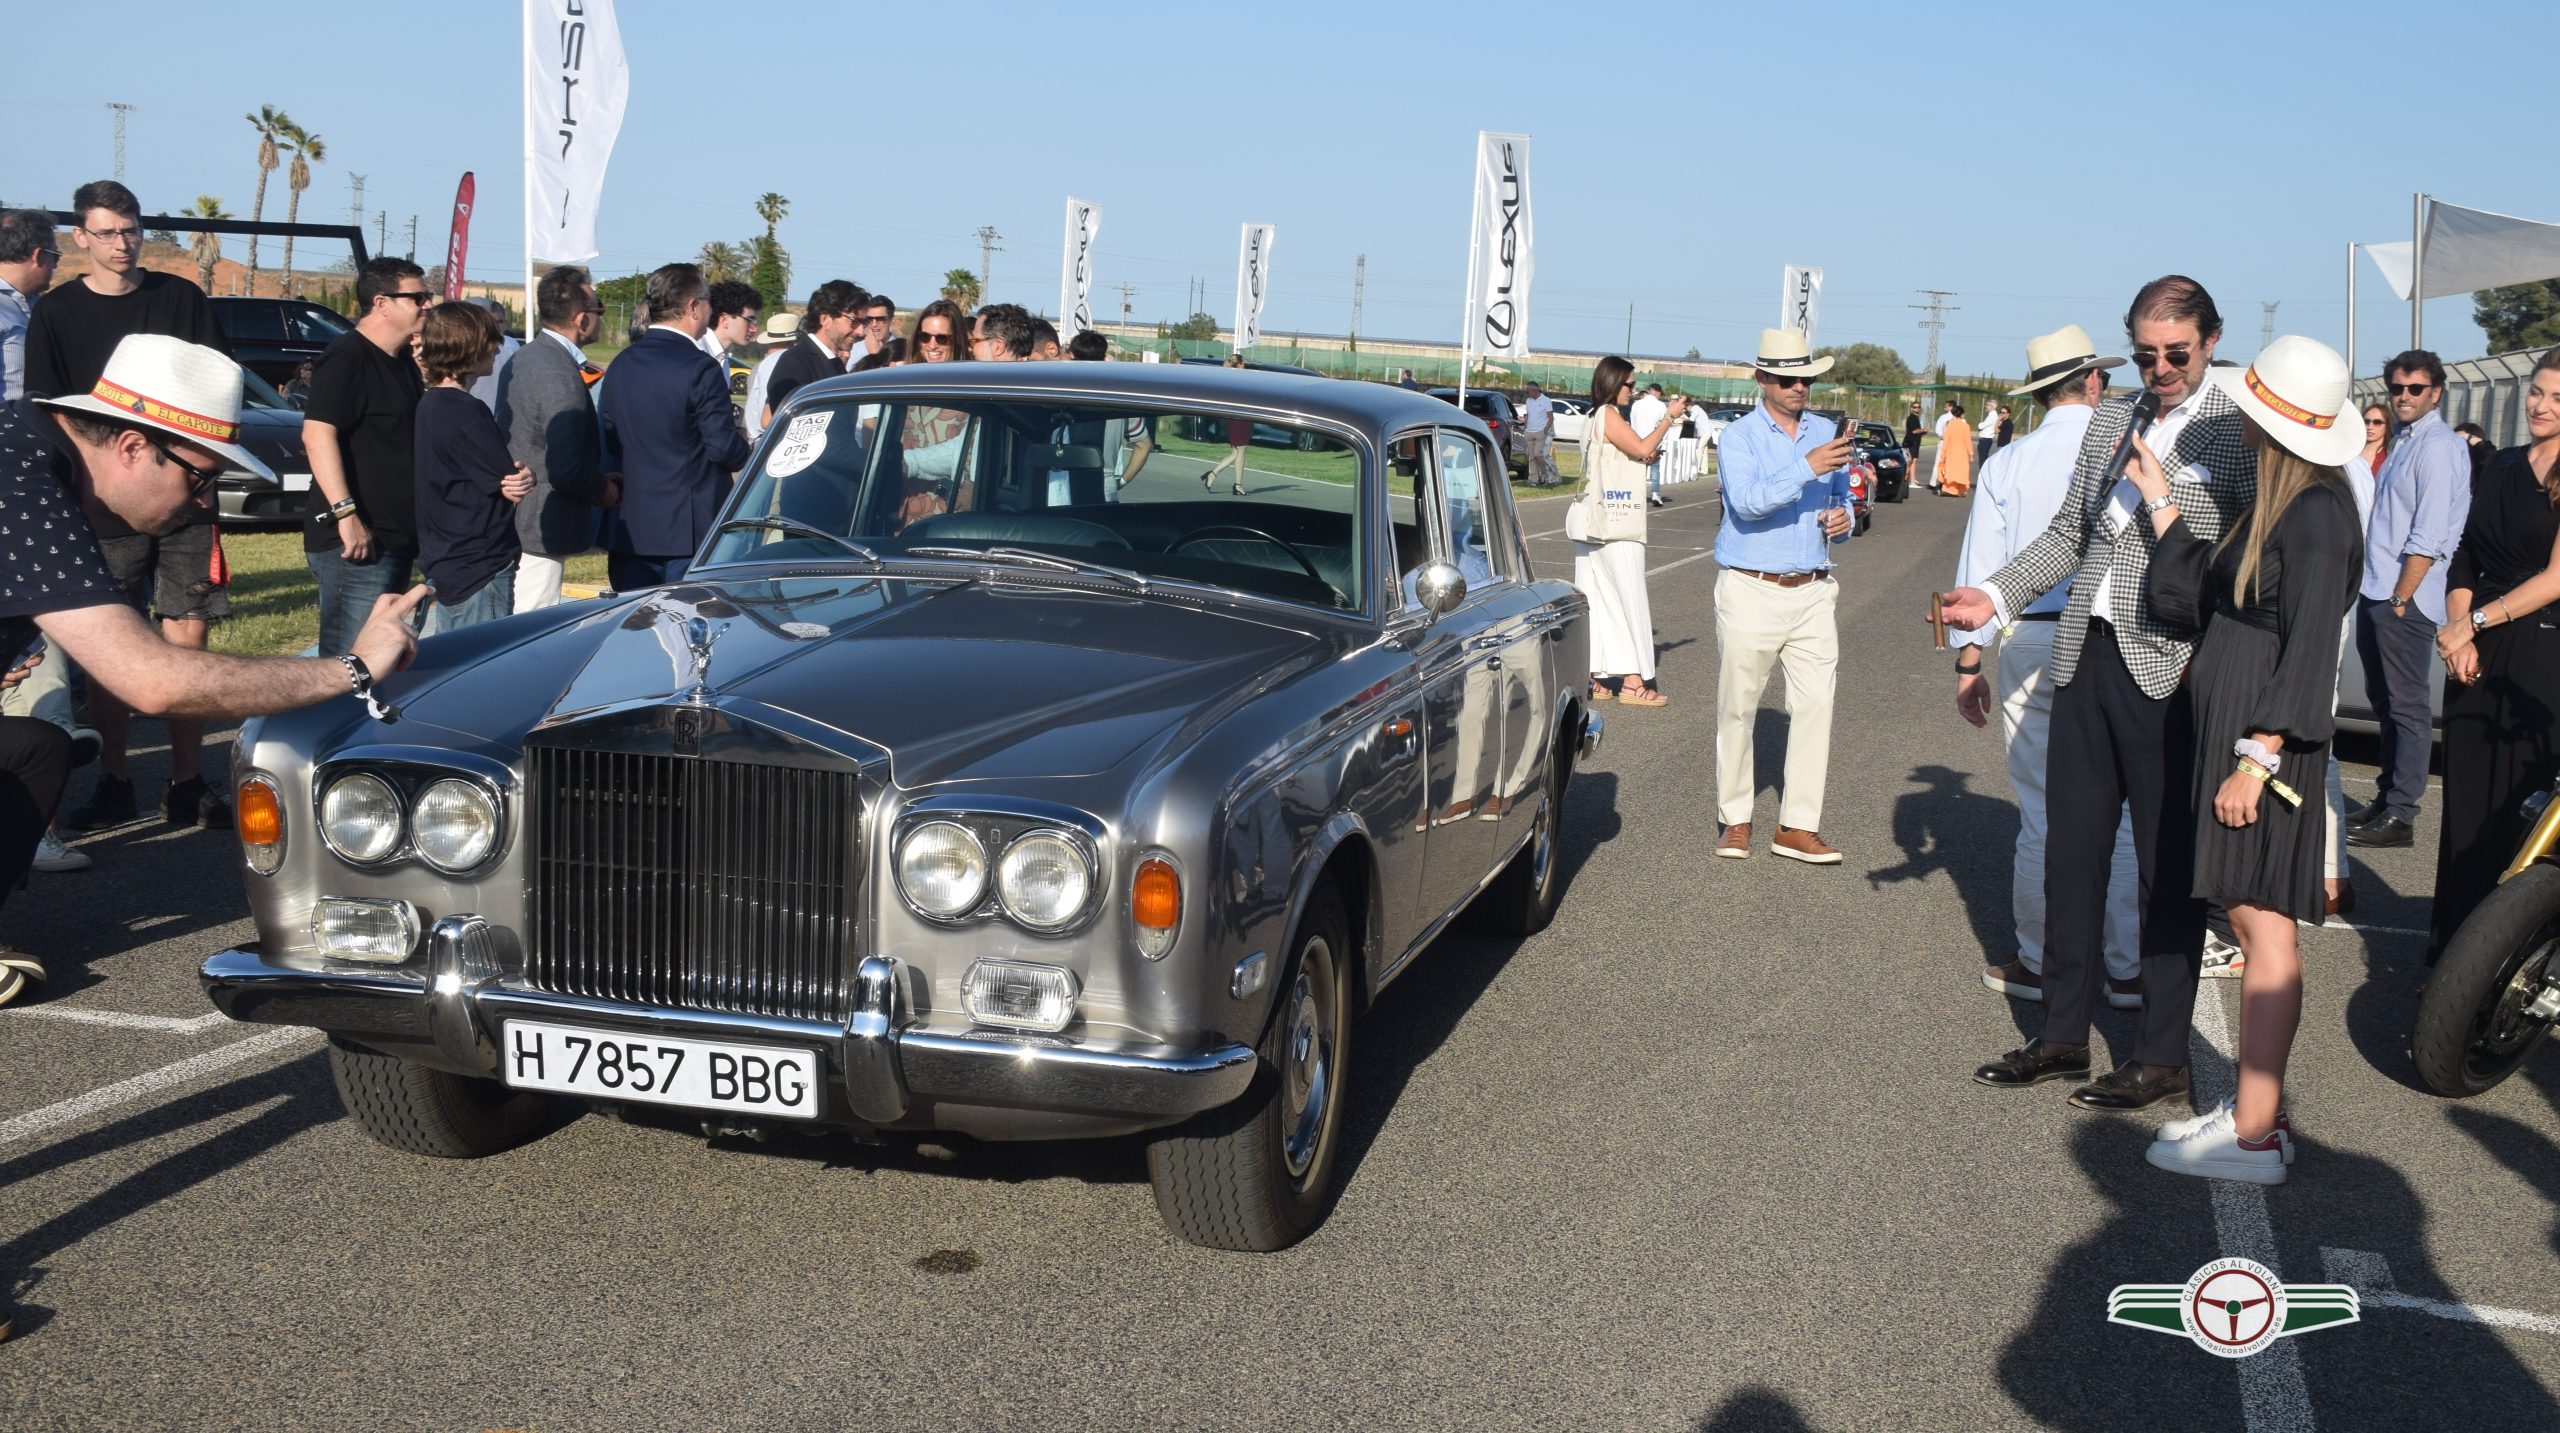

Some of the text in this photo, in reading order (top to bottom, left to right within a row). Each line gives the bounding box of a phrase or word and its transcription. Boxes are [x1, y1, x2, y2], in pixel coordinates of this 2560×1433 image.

[1497, 142, 1520, 294] LEXUS
[1797, 271, 1810, 338] EXUS
[158, 407, 224, 435] EL CAPOTE
[796, 415, 826, 428] TAG
[788, 425, 823, 440] HEUER
[784, 443, 809, 457] 078
[1606, 490, 1632, 500] BWT
[515, 1030, 804, 1107] H 7857 BBG
